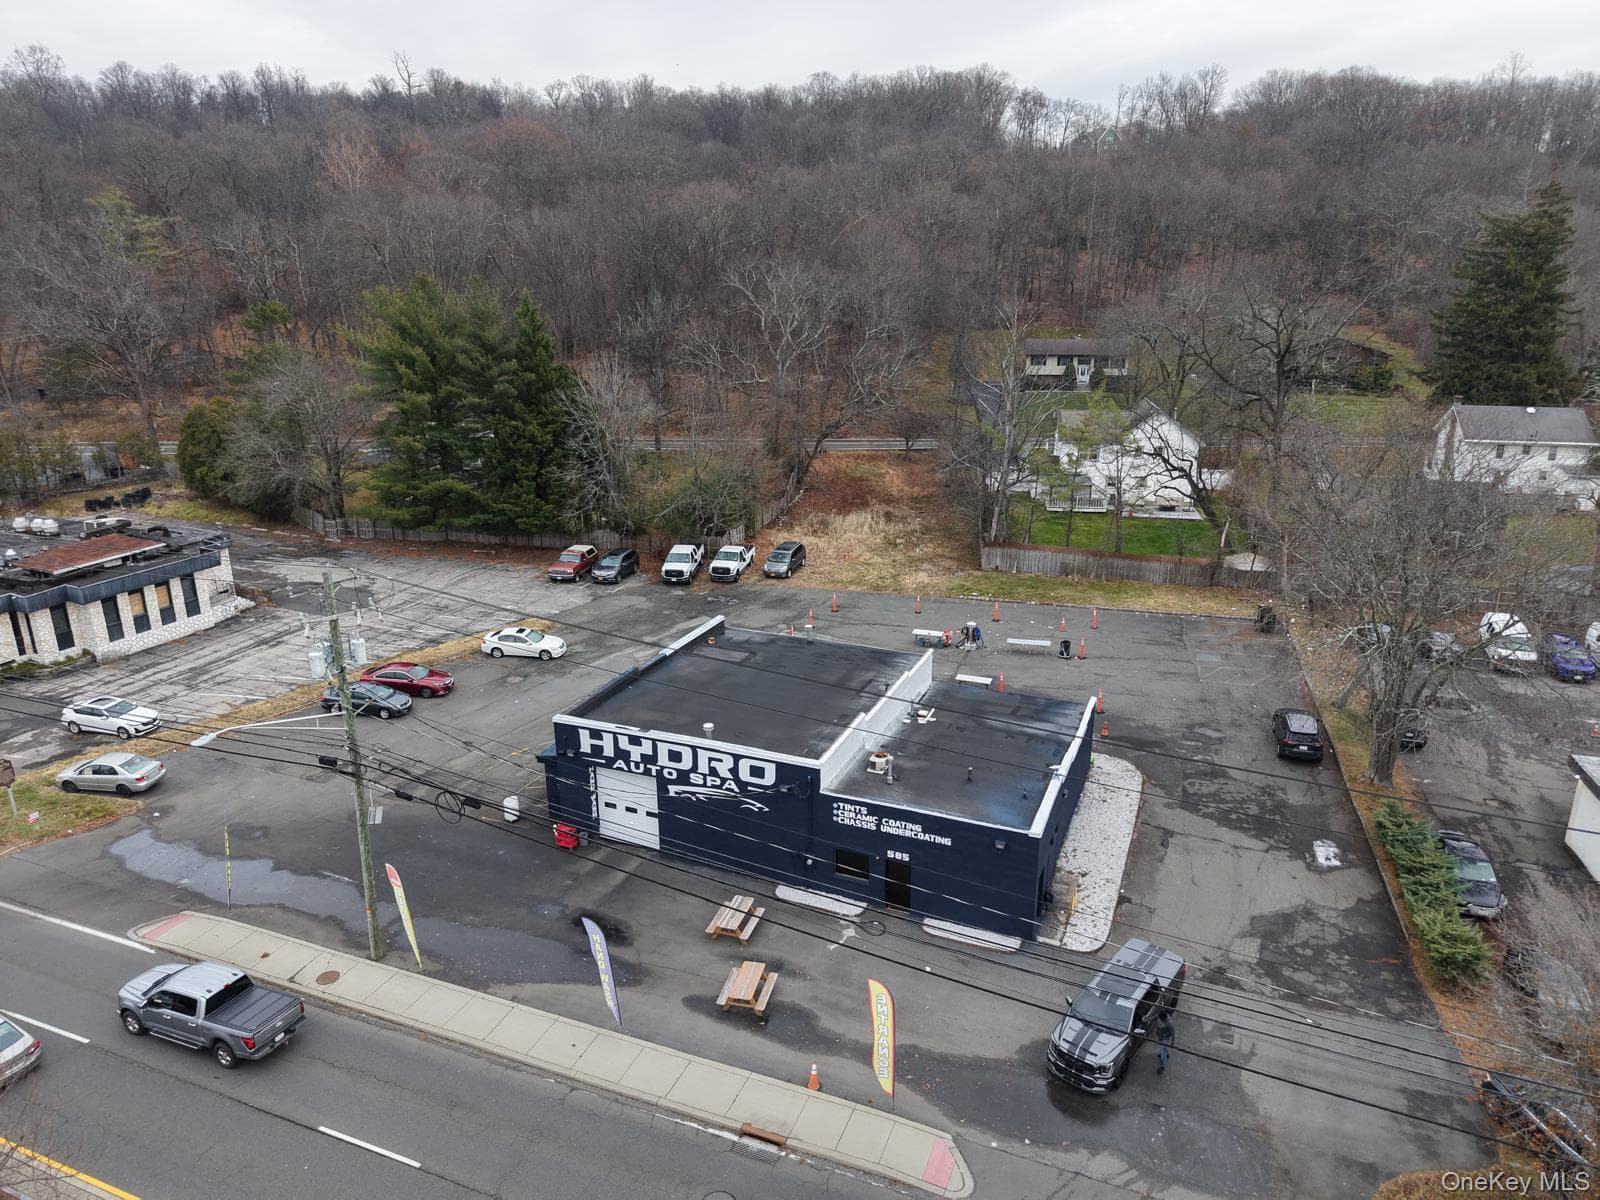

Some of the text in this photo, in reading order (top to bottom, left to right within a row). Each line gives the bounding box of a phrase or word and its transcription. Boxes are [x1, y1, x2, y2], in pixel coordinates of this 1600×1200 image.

[577, 728, 776, 786] HYDRO
[612, 759, 740, 792] AUTO SPA
[838, 802, 868, 815] TINTS
[838, 810, 922, 832] CERAMIC COATING
[838, 817, 952, 846] CHASSIS UNDERCOATING
[887, 850, 910, 862] 585
